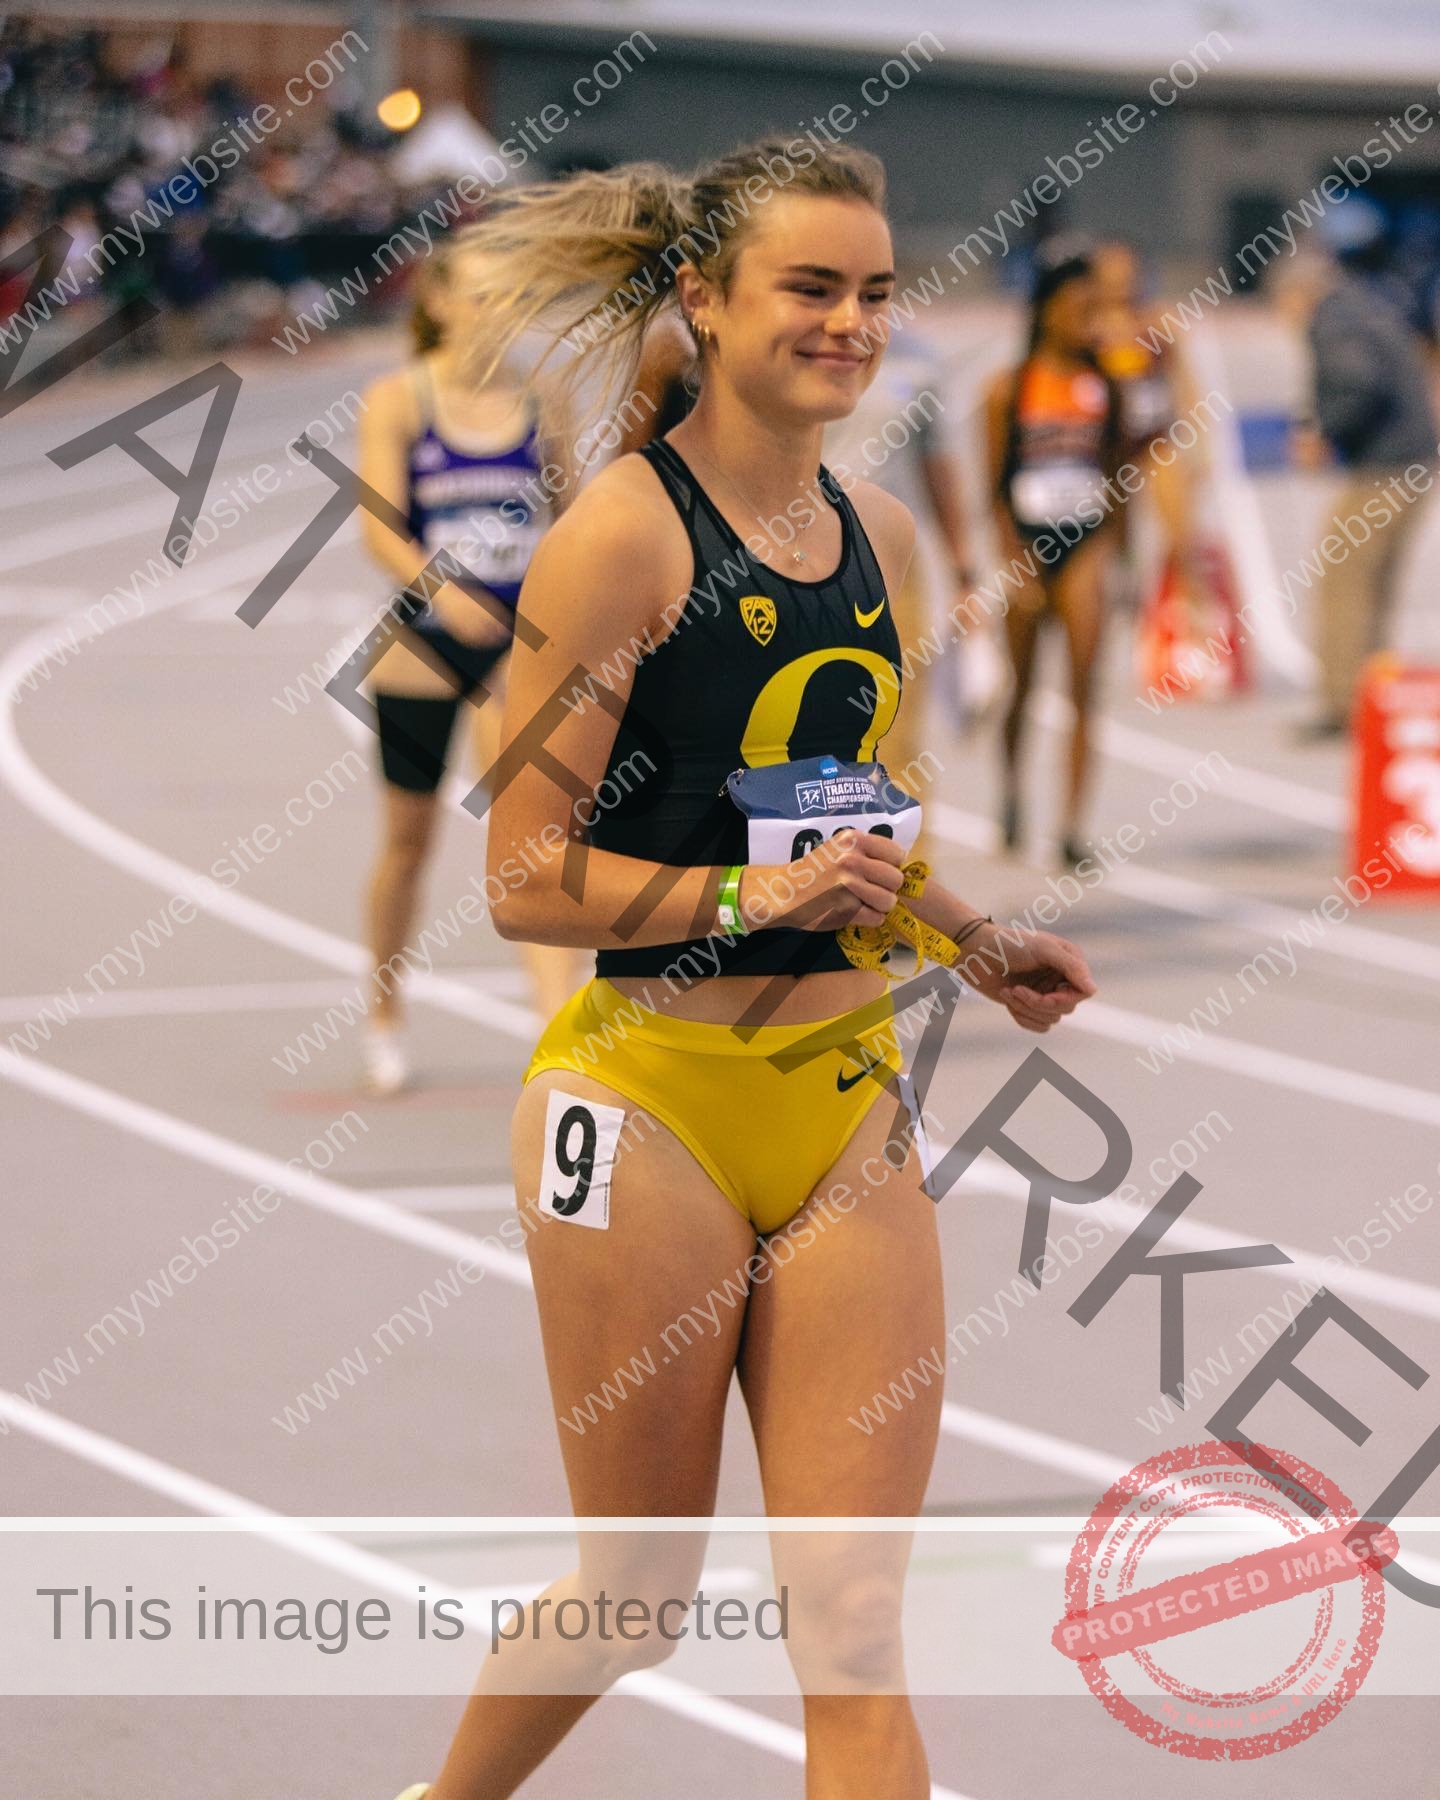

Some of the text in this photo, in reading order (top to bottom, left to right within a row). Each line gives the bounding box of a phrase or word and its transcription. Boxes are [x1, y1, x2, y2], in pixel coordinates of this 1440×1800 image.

[752, 616, 772, 635] 12
[824, 783, 854, 796] TRACK
[552, 1105, 597, 1216] 9
